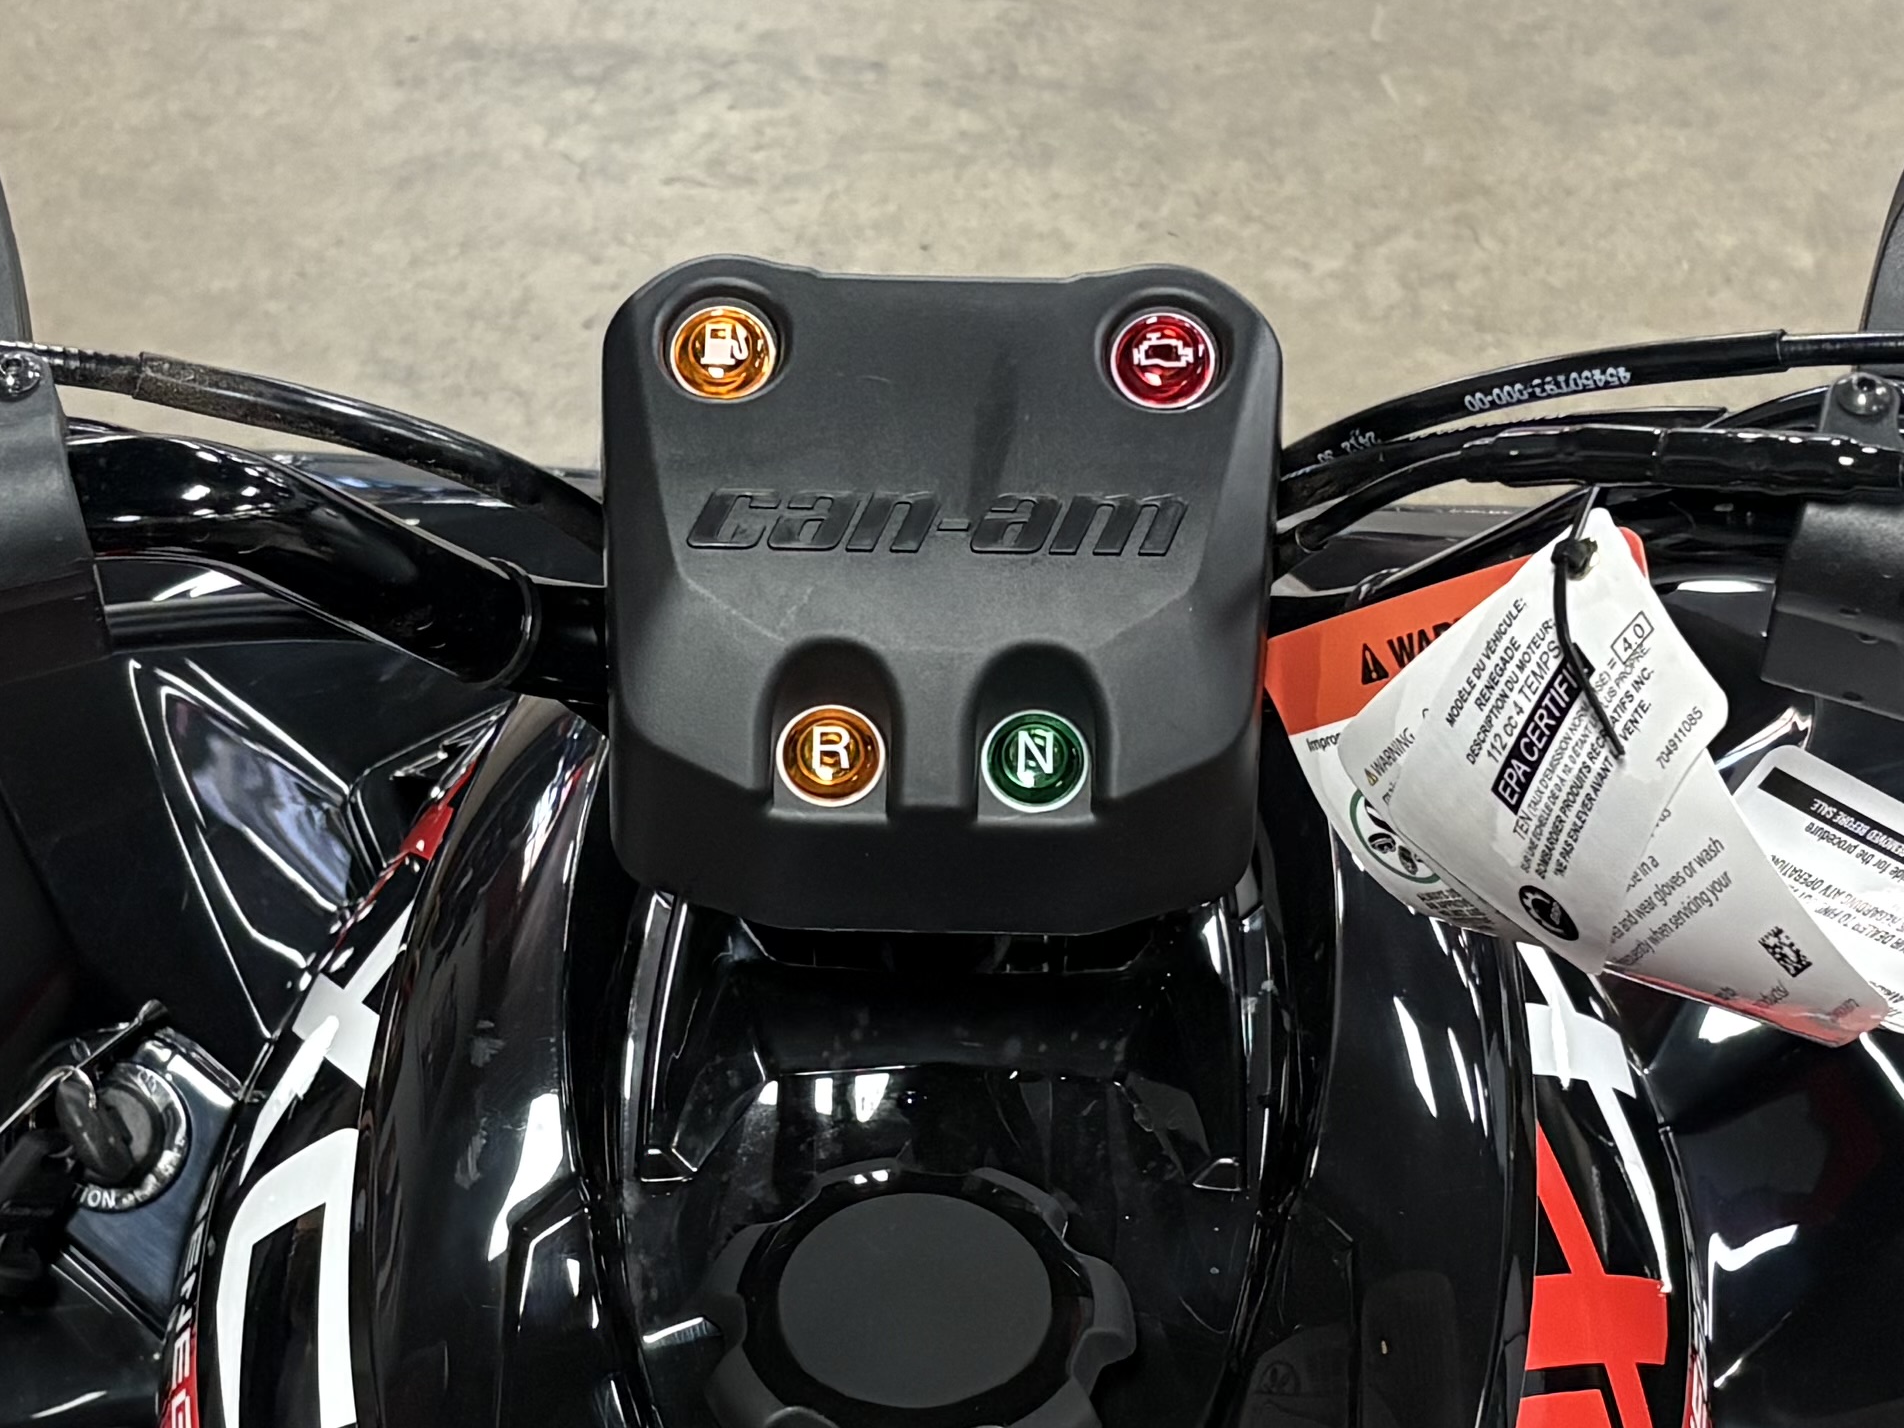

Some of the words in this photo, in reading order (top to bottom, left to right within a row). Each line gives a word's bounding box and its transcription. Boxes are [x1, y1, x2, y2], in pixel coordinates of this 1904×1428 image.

[1474, 636, 1521, 712] RENEGADE
[1486, 732, 1508, 764] 112
[1517, 639, 1566, 703] TEMPS
[811, 725, 850, 770] R
[1016, 729, 1055, 774] N
[1465, 689, 1510, 765] DESCRIPTION
[1512, 809, 1533, 841] TEN
[1622, 622, 1646, 653] 4.0
[1497, 758, 1531, 805] EPA
[1559, 761, 1592, 819] PRODUITS
[1590, 755, 1614, 798] AVANT
[1804, 821, 1860, 855] procedure
[1649, 870, 1687, 907] gloves
[1692, 837, 1725, 868] wash
[1668, 890, 1719, 930] servicing
[1702, 870, 1733, 902] your
